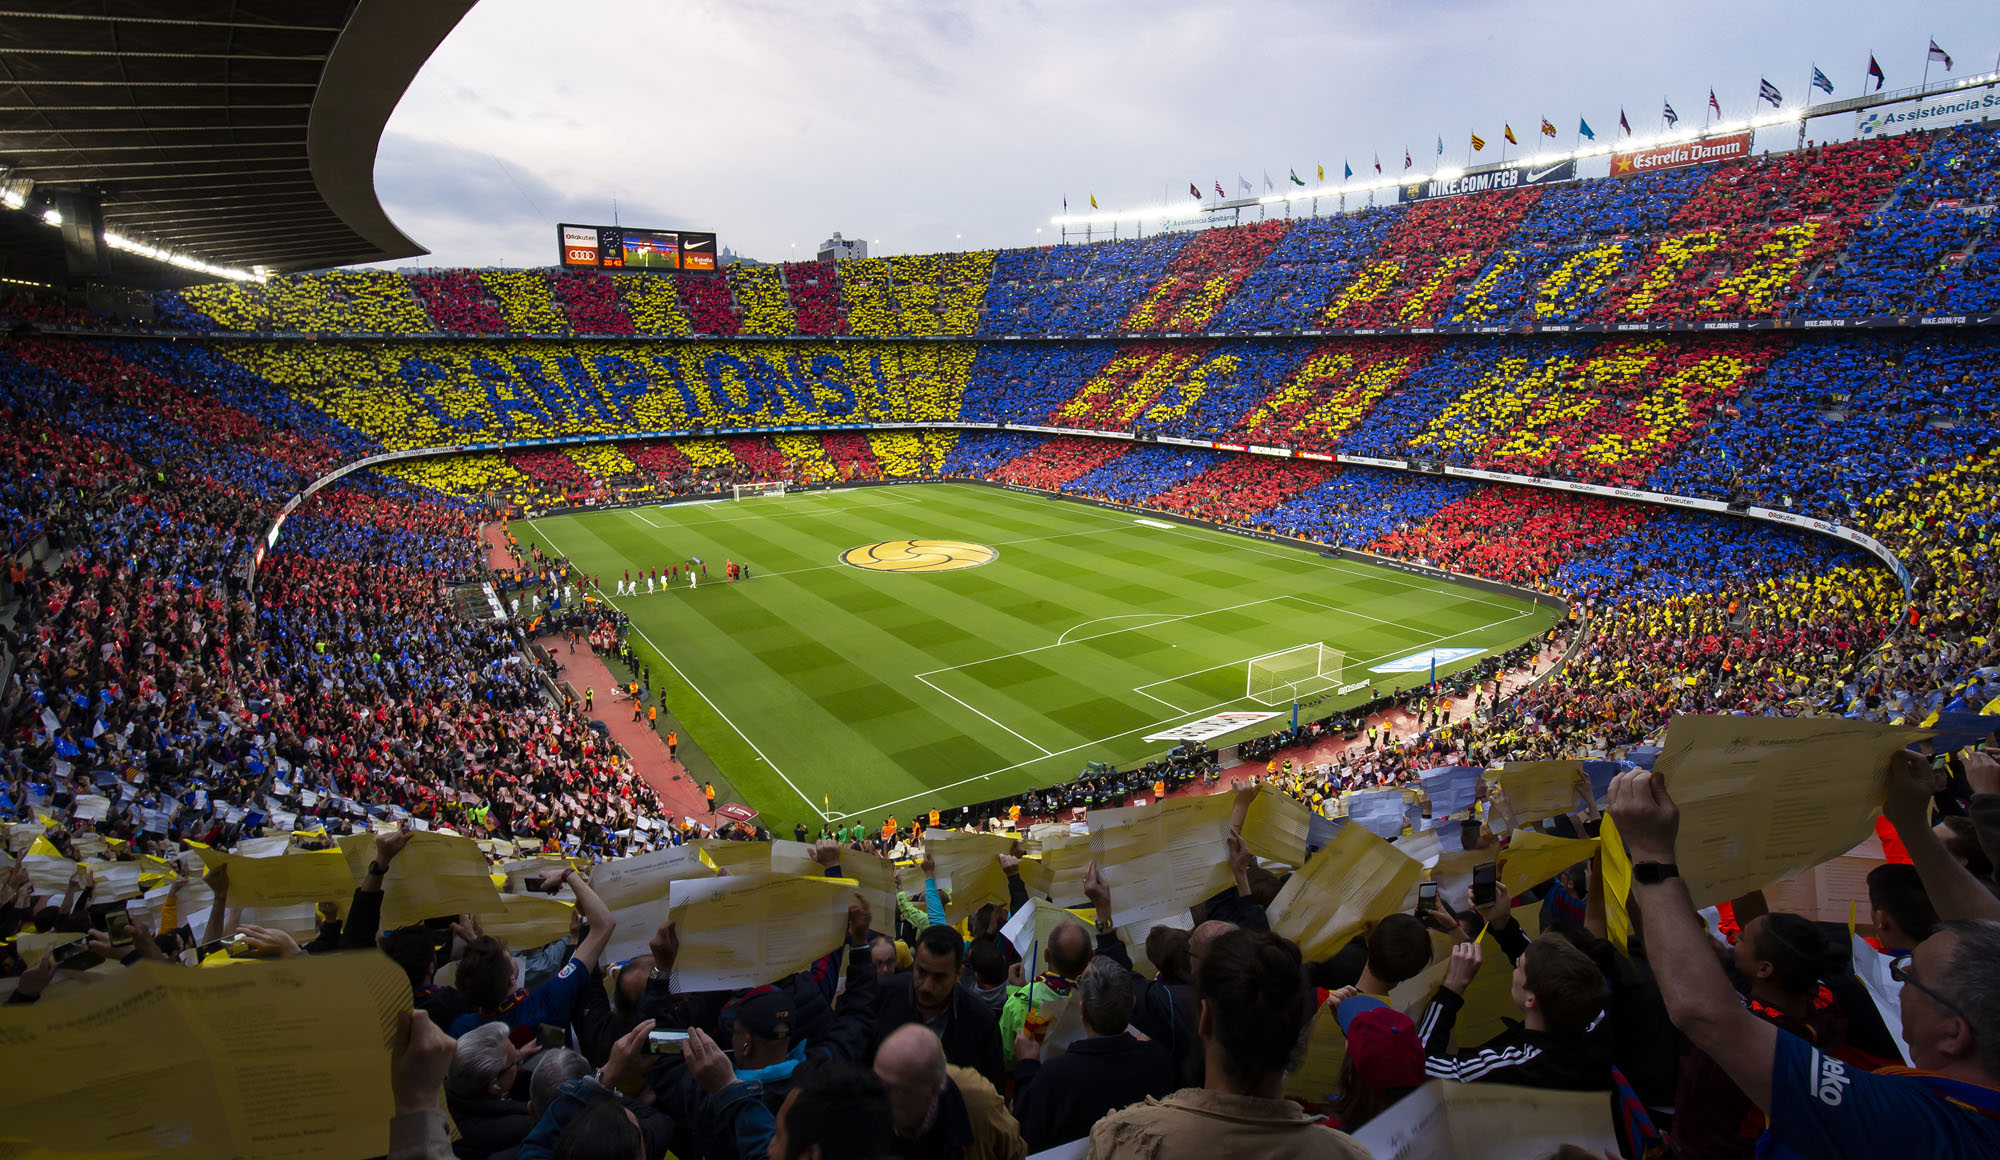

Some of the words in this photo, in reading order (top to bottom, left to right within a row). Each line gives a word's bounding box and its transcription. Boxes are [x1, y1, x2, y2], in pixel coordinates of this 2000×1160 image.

[1884, 99, 1980, 124] Assistència
[1633, 145, 1689, 170] Estrella
[1690, 141, 1741, 163] Damm
[1428, 169, 1518, 198] NIKE.COM/FCB
[1804, 319, 1845, 327] NIKE.COM/FCB
[1921, 316, 1966, 325] NIKE.COM/FCB
[1574, 483, 1596, 491] Rakuten
[1620, 489, 1643, 498] Rakuten
[1669, 497, 1694, 506] Rakuten
[1773, 511, 1797, 523] Rakuten
